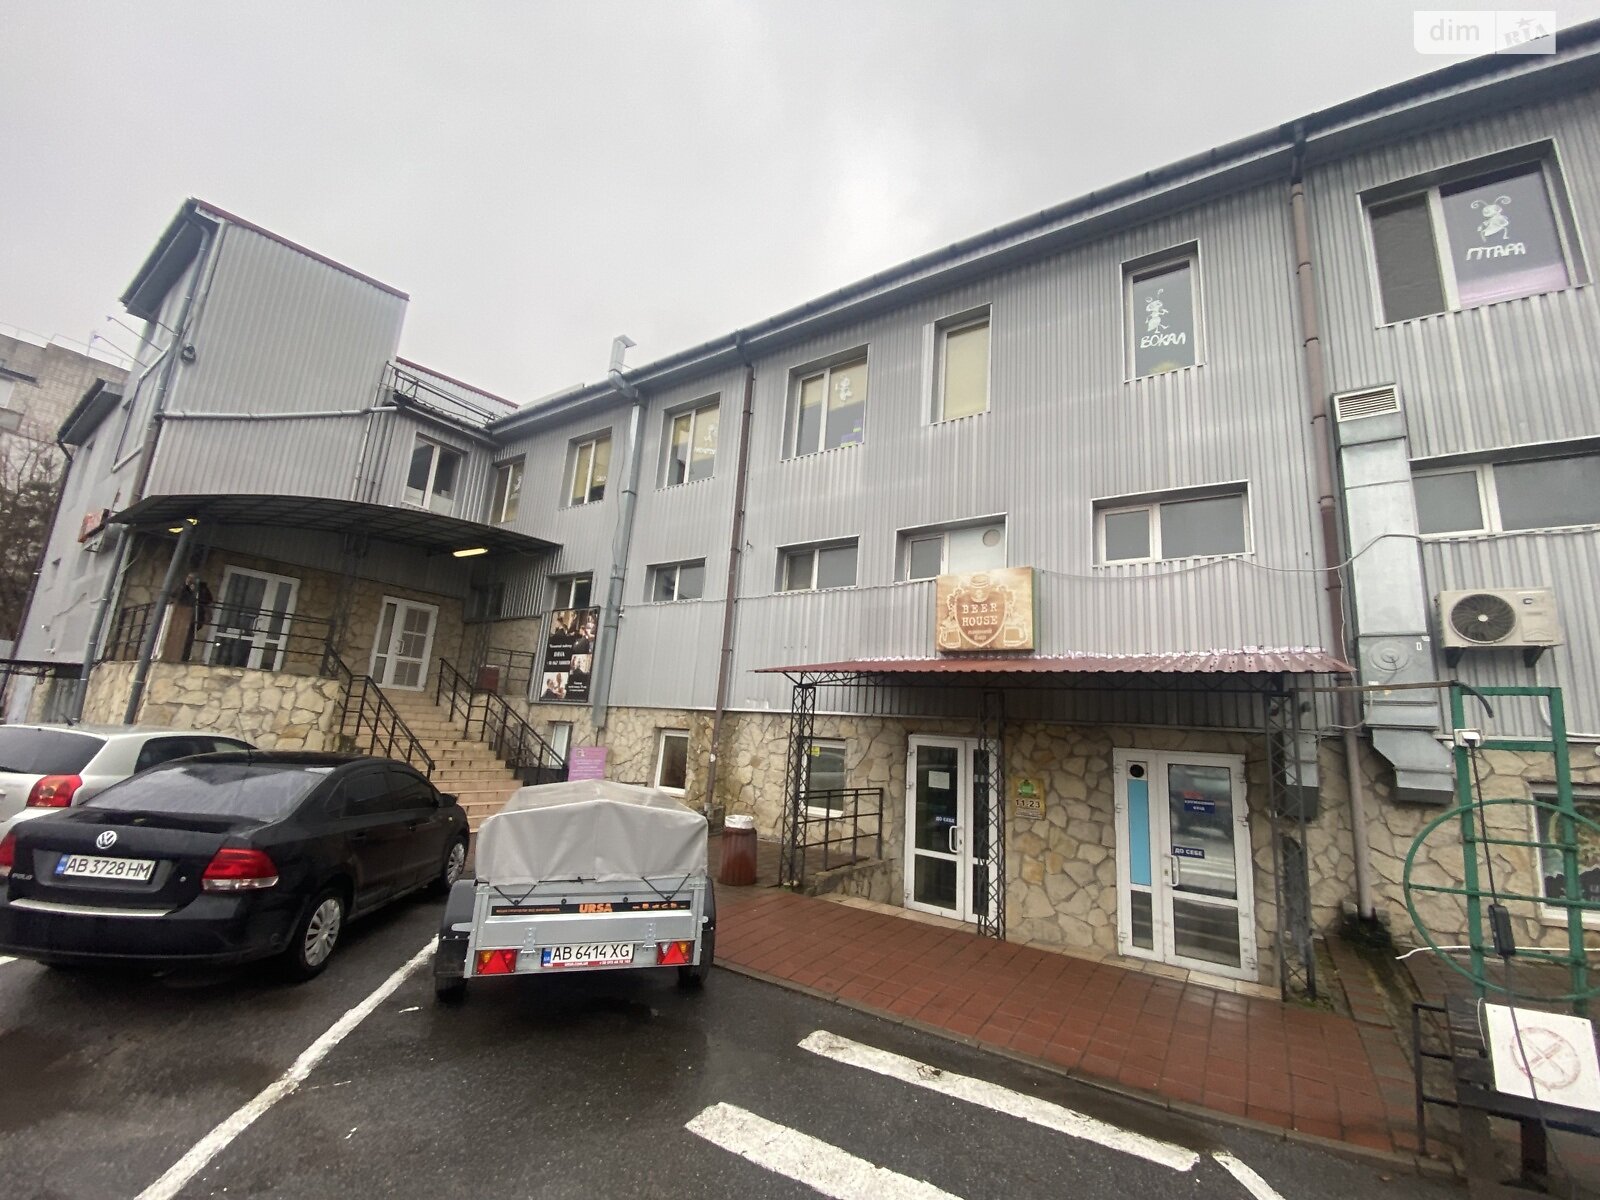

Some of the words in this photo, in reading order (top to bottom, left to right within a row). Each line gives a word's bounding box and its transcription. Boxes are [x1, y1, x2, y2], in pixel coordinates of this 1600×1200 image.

[962, 602, 998, 614] BEER
[962, 615, 998, 627] HOUSE
[1185, 849, 1203, 857] СЕБЕ
[65, 857, 89, 873] AB
[89, 859, 126, 876] 3728
[125, 861, 151, 879] HM
[579, 902, 613, 913] URSA
[552, 946, 572, 961] AB
[575, 943, 607, 960] 6414
[610, 944, 630, 957] XG
